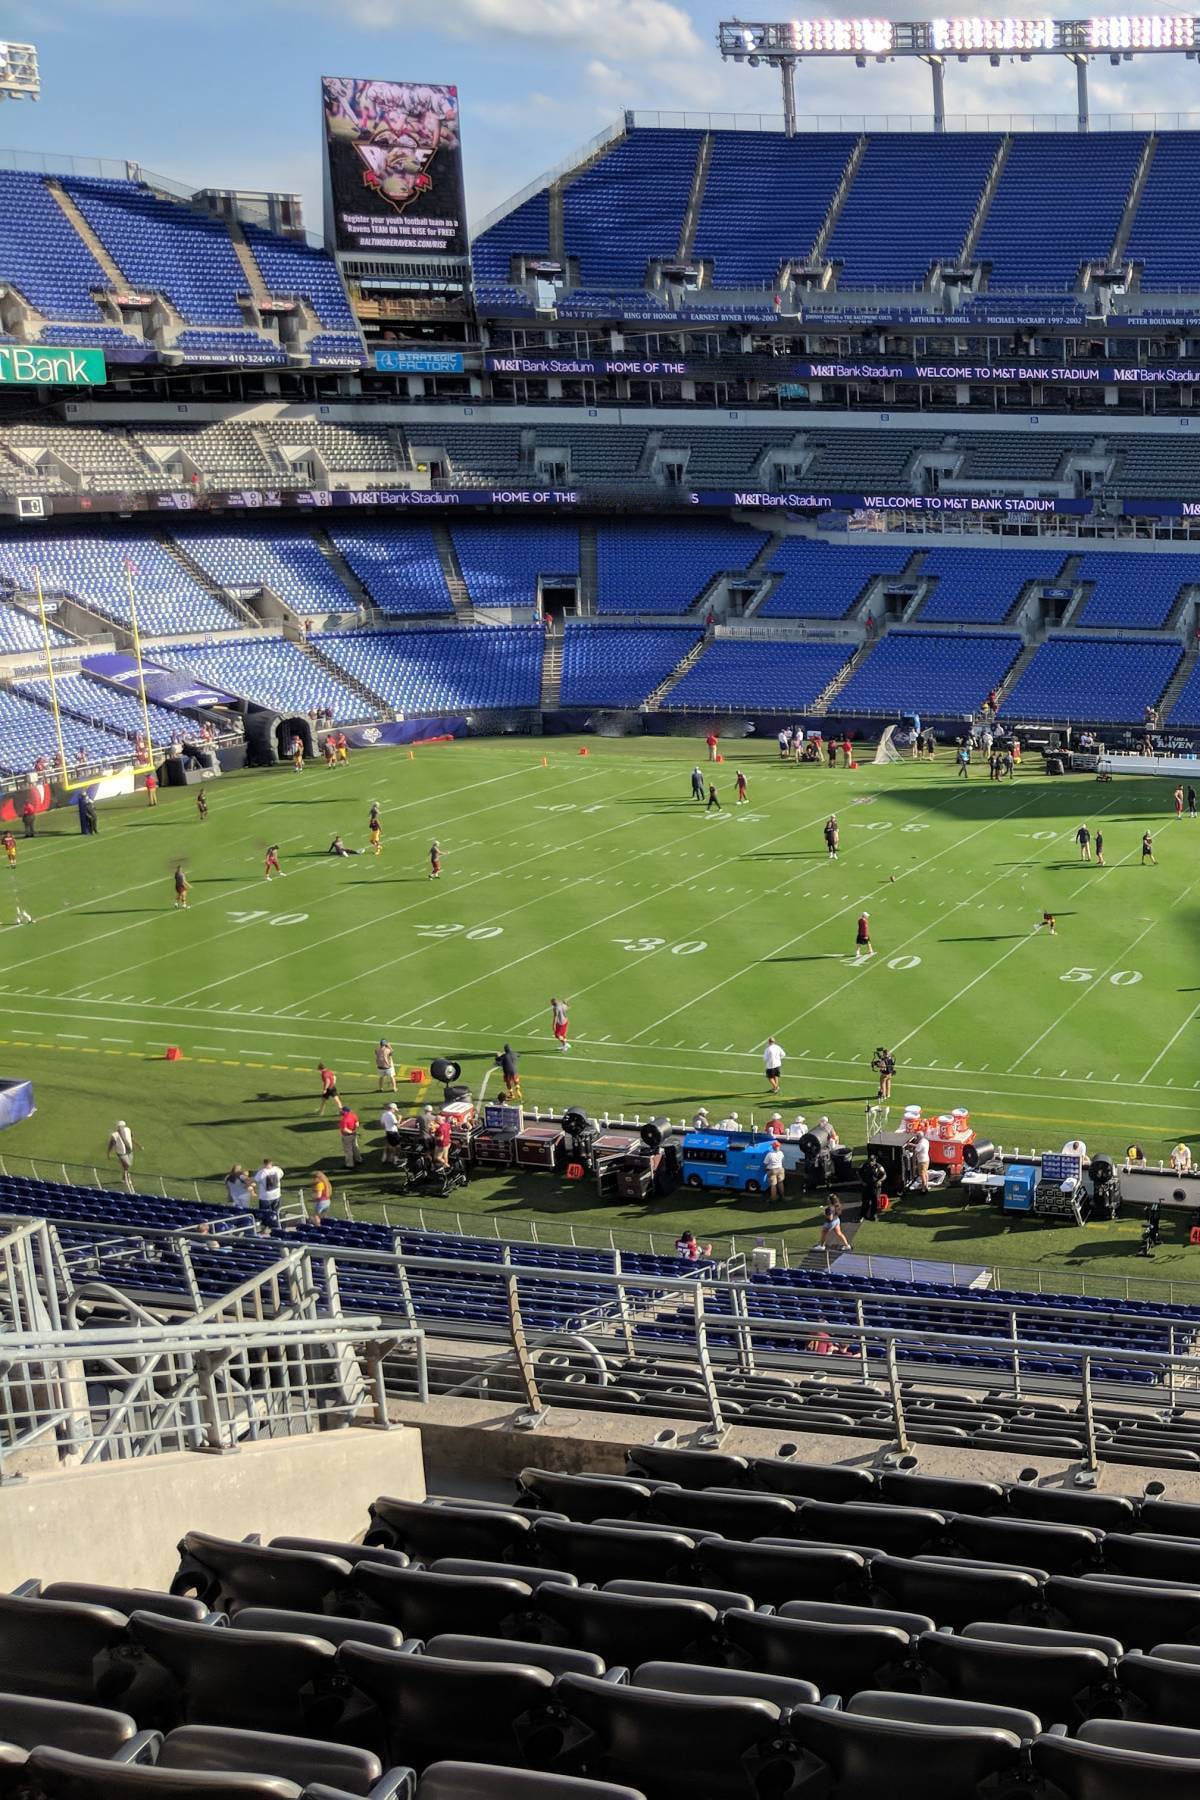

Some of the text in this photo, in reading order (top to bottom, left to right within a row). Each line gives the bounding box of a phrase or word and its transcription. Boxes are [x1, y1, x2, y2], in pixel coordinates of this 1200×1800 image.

[343, 214, 369, 223] Register
[371, 216, 385, 225] your
[386, 216, 403, 225] youth
[404, 216, 428, 225] football
[429, 218, 445, 226] team
[348, 225, 371, 233] Ravens
[372, 226, 388, 234] TEAM
[389, 226, 398, 234] ON
[399, 227, 412, 235] THE
[412, 227, 427, 235] RISE
[560, 310, 593, 318] SMYTH
[655, 312, 678, 320] HONOR
[691, 313, 720, 321] EARNEST
[909, 316, 933, 324] ARTHUR
[318, 357, 361, 366] RAVENS
[398, 353, 457, 362] STRATEGIC
[13, 350, 90, 383] Bank
[398, 361, 457, 370] FACTORY
[494, 359, 595, 372] M&T Bank Stadium
[606, 362, 685, 373] HOME OF THE
[810, 365, 903, 377] M&T Bank Stadium
[916, 367, 1099, 379] WELCOME TO M&T BANK STADIUM
[1113, 369, 1140, 380] M&T
[1140, 369, 1166, 380] Bank
[349, 492, 459, 504] M&T Bank Stadium
[492, 492, 576, 502] HOME OF THE
[734, 493, 832, 506] M&T Bank Stadium
[864, 496, 1055, 511] WELCOME TO M&T BANK STADIUM
[1157, 741, 1194, 749] RAVEN
[417, 923, 504, 940] 20
[624, 937, 708, 955] 30
[1059, 967, 1143, 985] 50
[570, 1166, 580, 1176] 40
